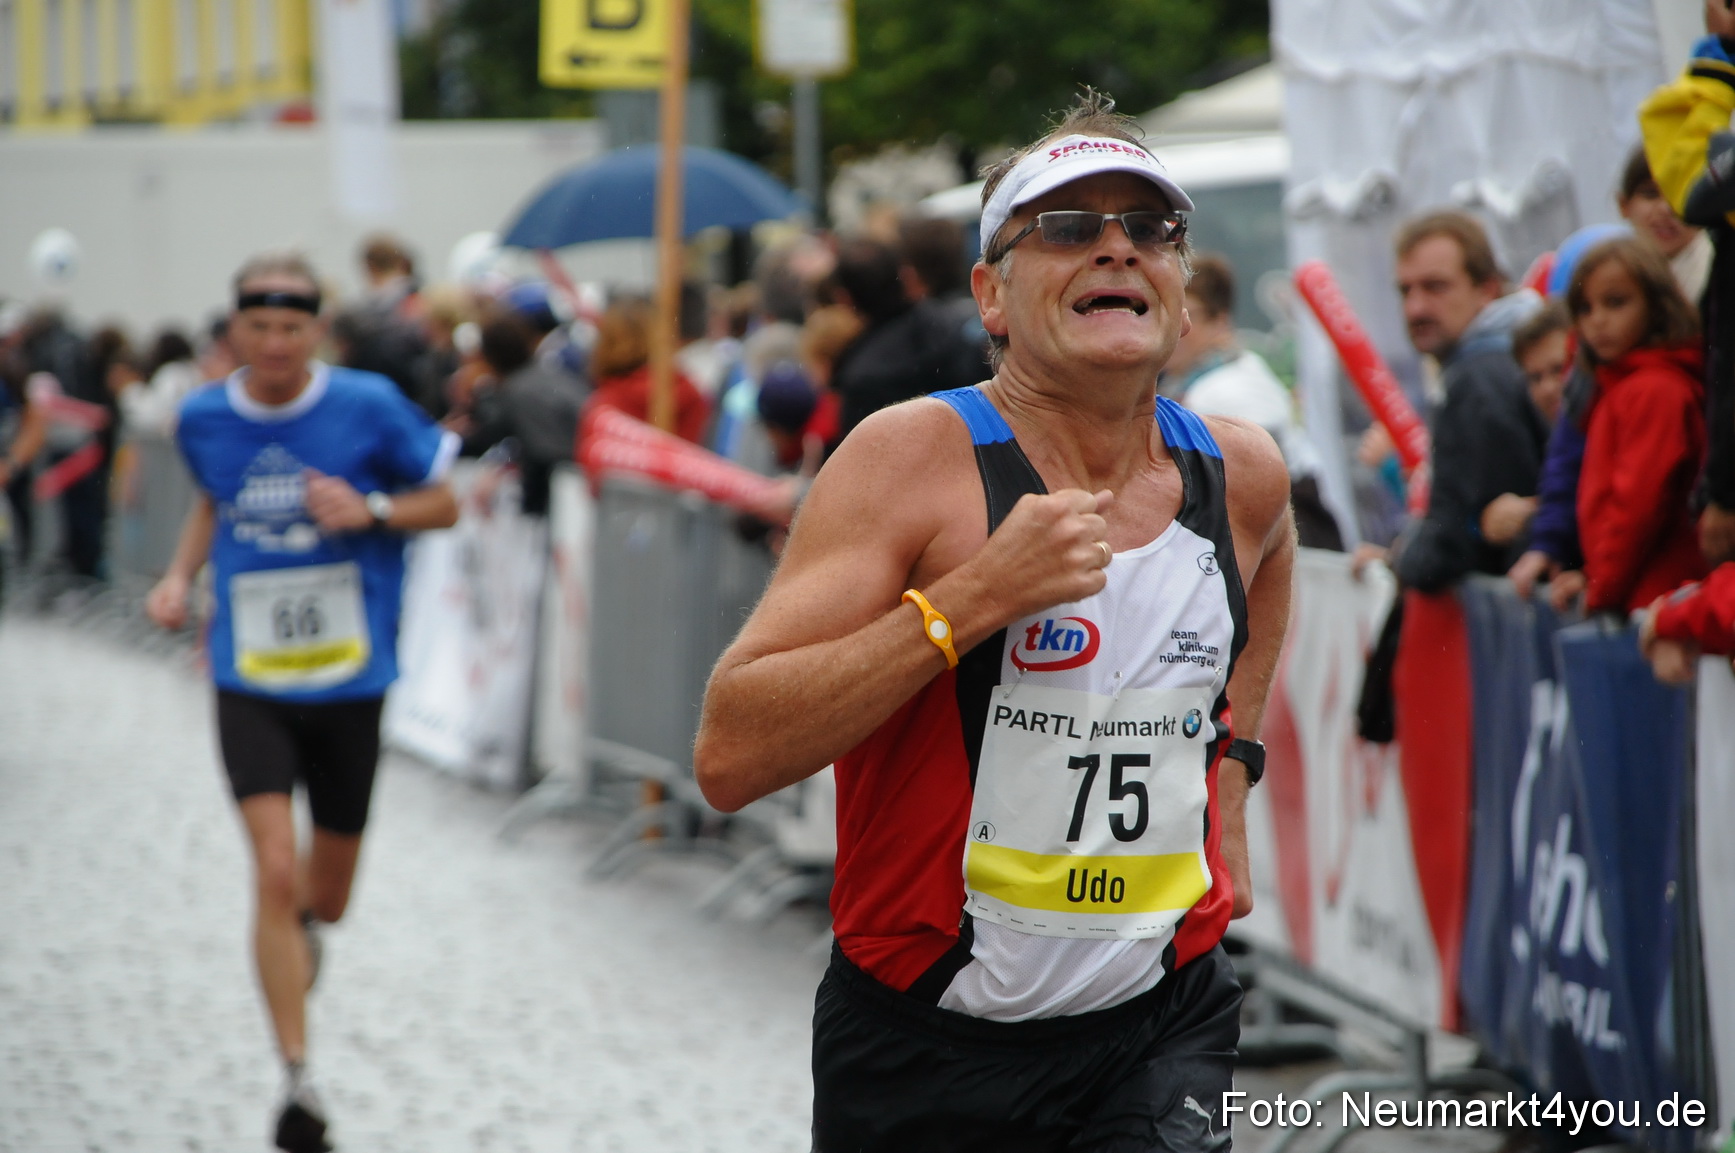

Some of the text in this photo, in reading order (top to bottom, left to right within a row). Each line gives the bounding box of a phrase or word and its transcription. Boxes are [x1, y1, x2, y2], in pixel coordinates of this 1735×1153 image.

[1025, 619, 1084, 651] tkn
[1171, 630, 1198, 640] team
[1178, 640, 1218, 655] klinikum
[993, 705, 1082, 739] PARTL
[1066, 754, 1151, 842] 75
[978, 825, 989, 840] A
[1066, 869, 1126, 904] Udo
